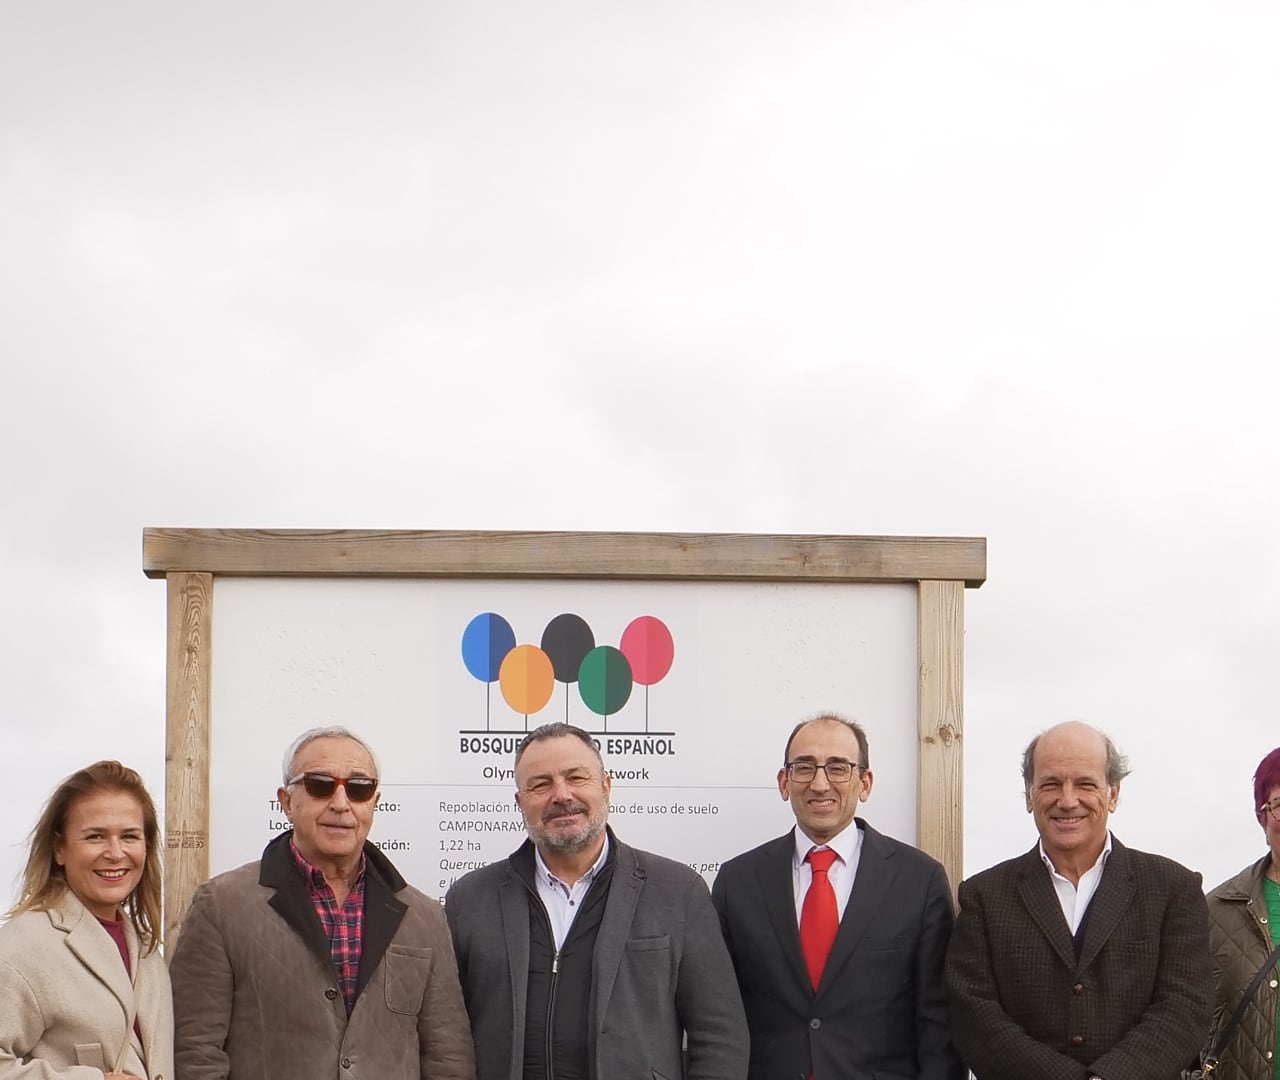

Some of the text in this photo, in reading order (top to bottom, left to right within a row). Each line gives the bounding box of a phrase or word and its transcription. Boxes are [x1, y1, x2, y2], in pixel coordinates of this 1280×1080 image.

[607, 736, 675, 755] ESPAÑOL
[439, 801, 510, 815] Repoblación
[629, 803, 644, 814] de
[647, 805, 667, 814] uso
[670, 803, 685, 814] de
[688, 803, 719, 815] suelo
[440, 840, 481, 852] 1,22 ha
[440, 859, 487, 871] Quercus
[700, 862, 720, 874] pet
[439, 880, 446, 888] e
